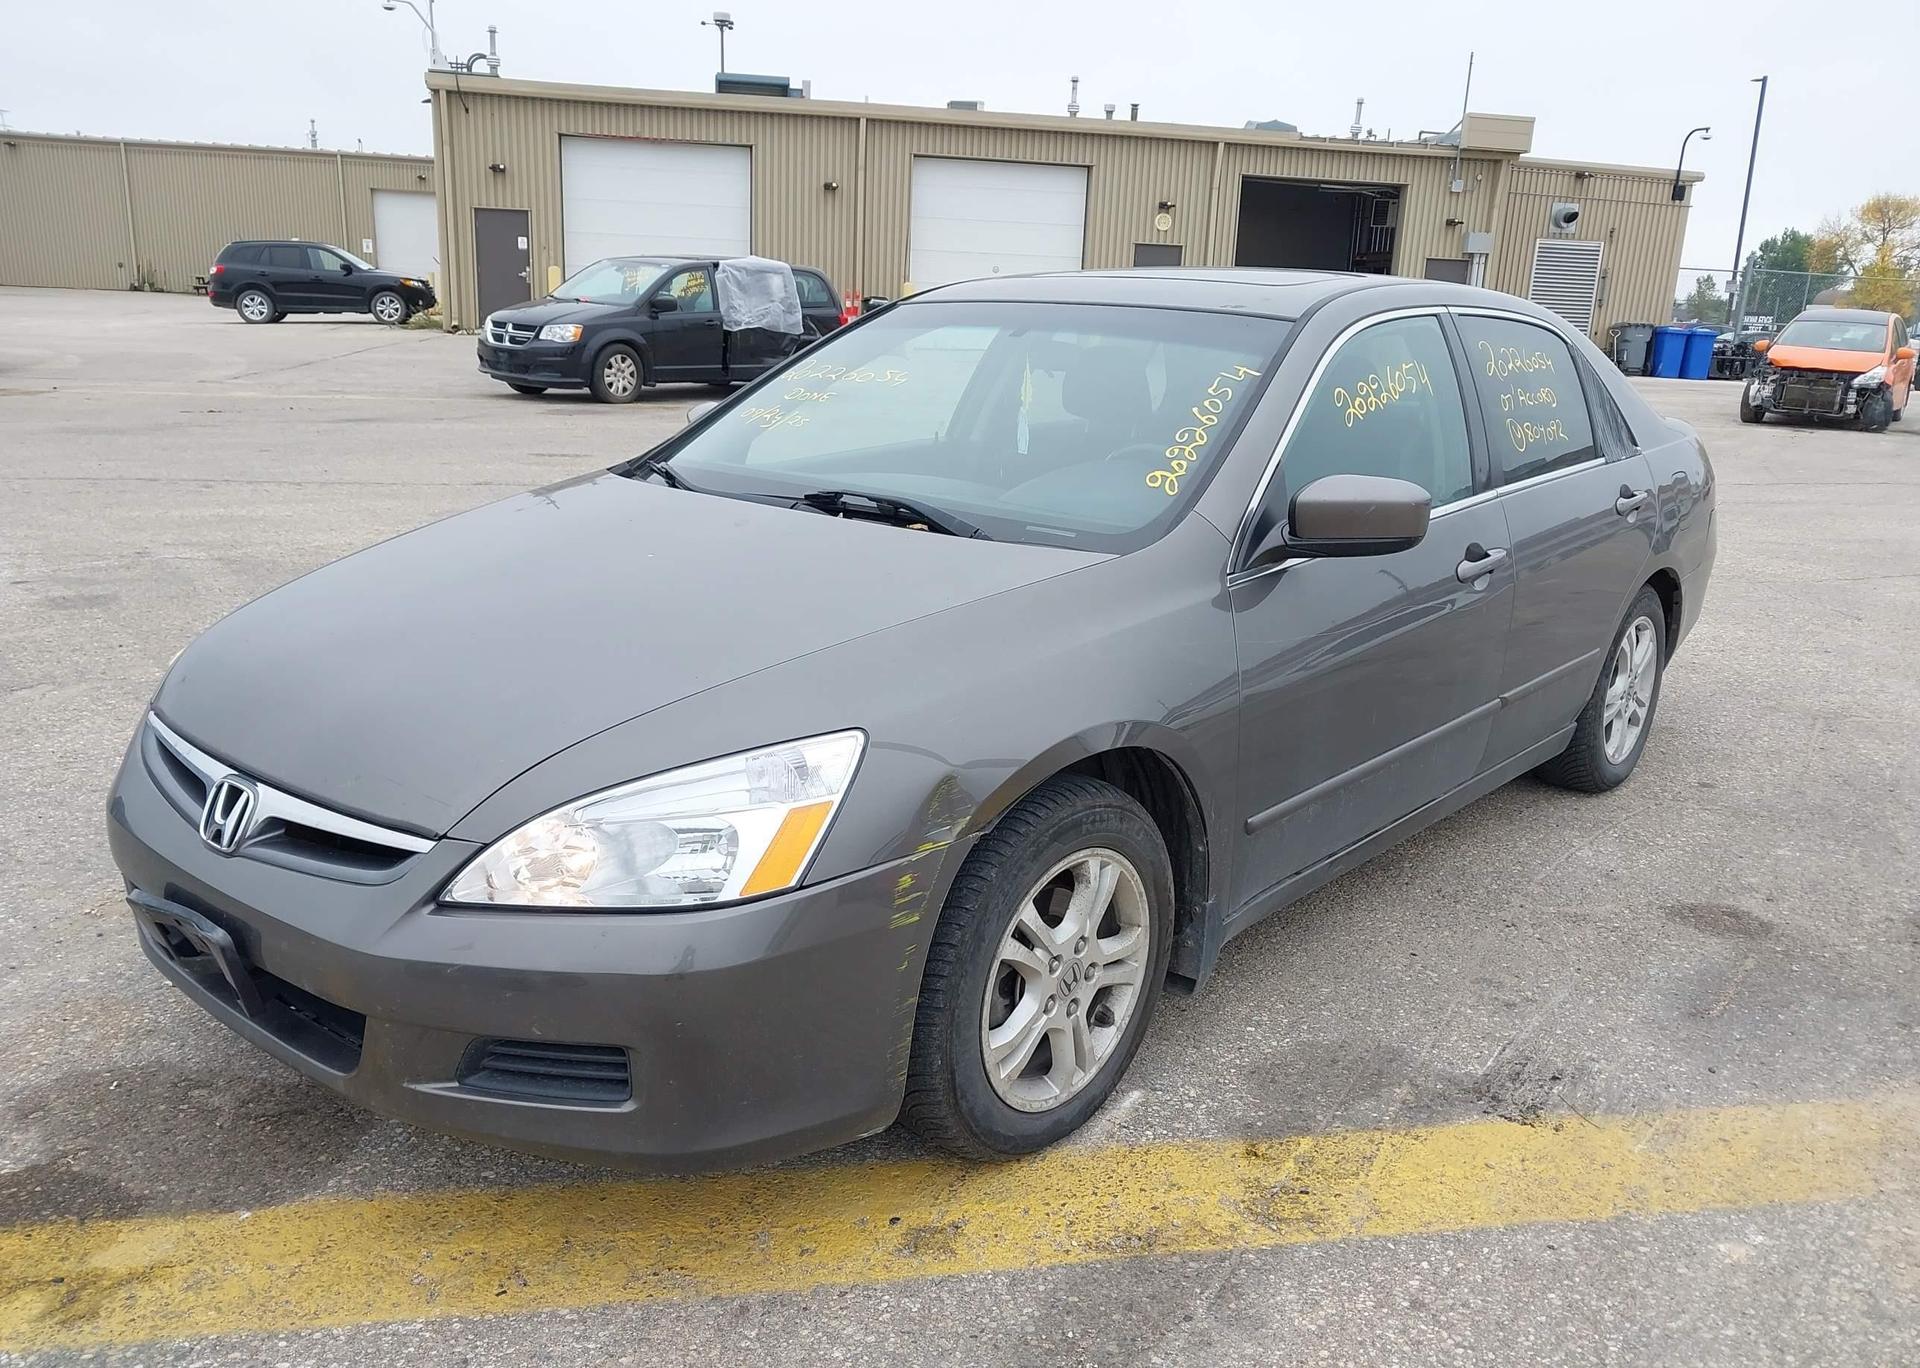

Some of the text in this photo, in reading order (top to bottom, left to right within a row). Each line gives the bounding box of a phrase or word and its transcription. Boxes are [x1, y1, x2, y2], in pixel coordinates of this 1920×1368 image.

[1478, 340, 1556, 382] 20226054
[784, 387, 838, 402] DONE
[1334, 360, 1434, 428] 20226054
[1145, 365, 1262, 496] 20226054
